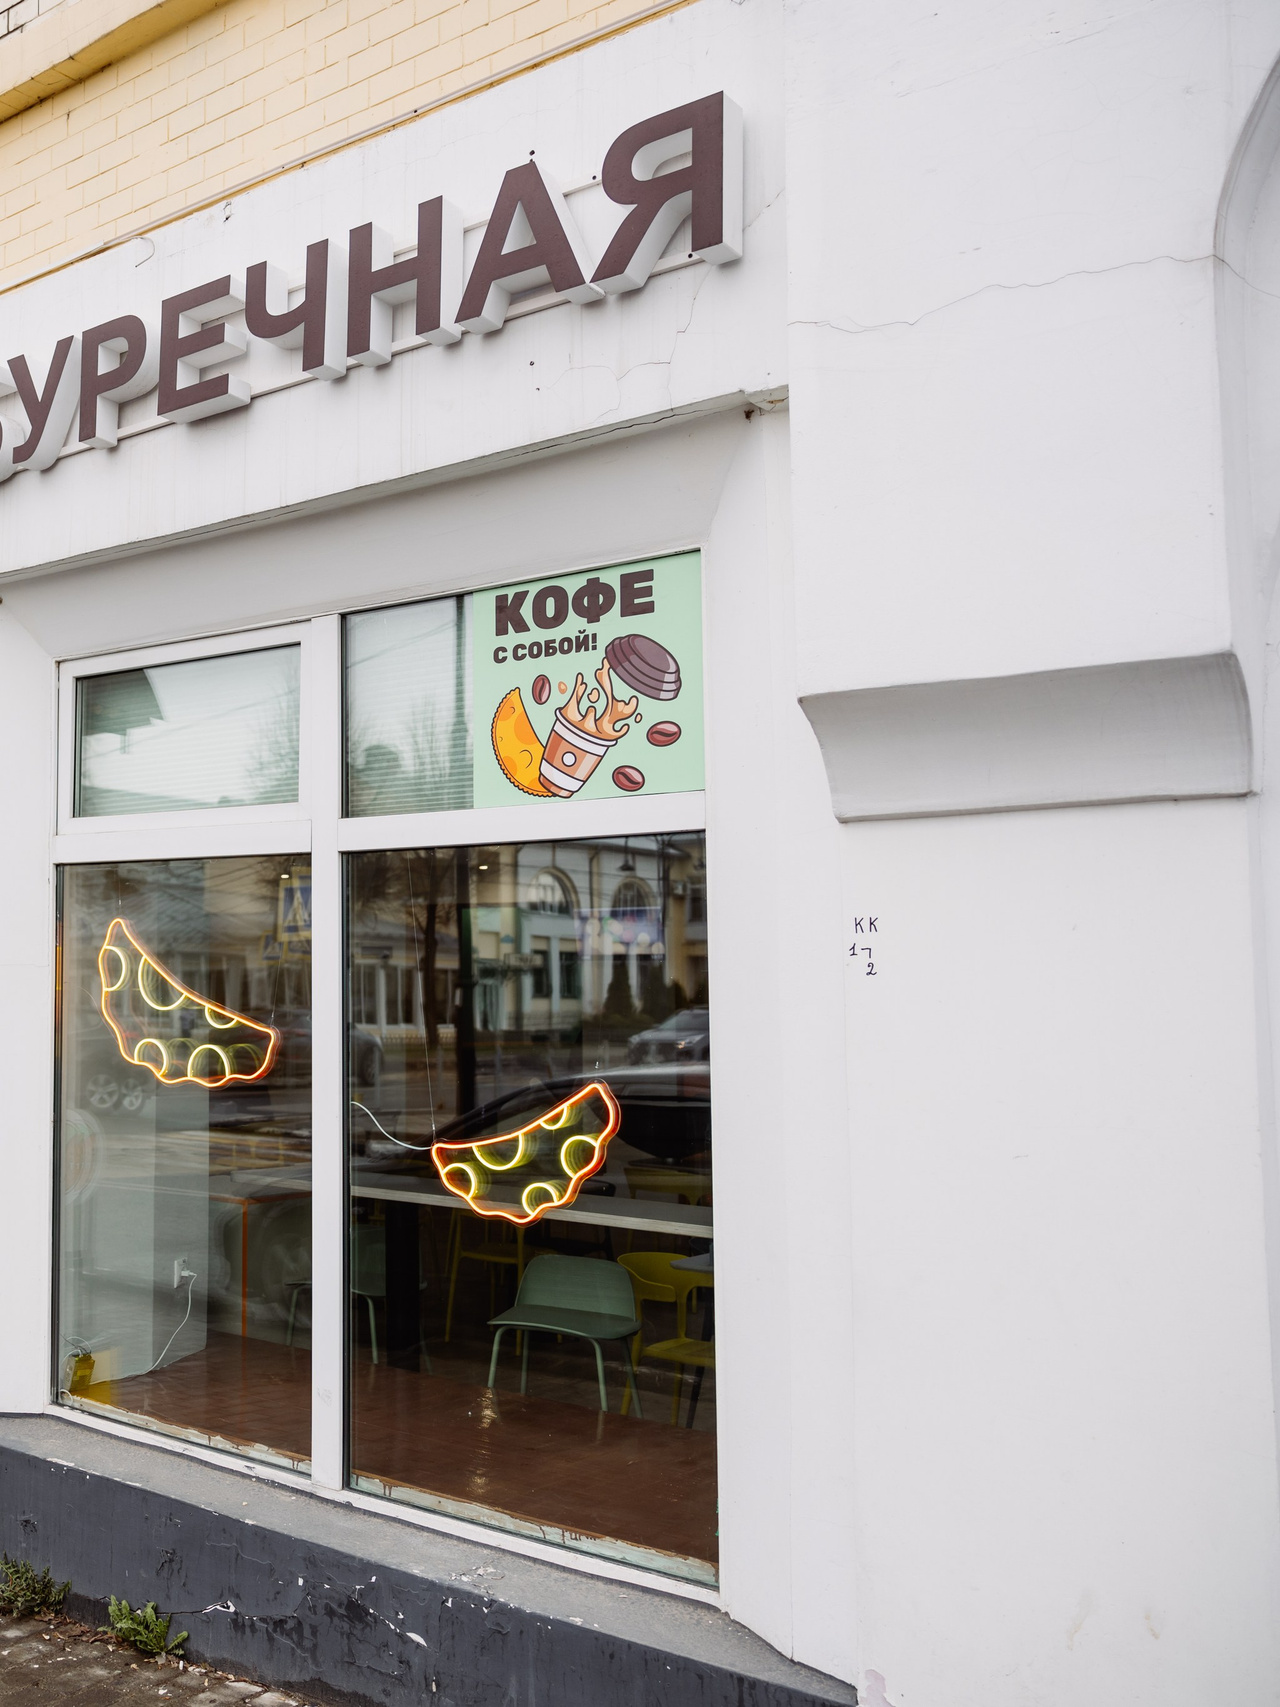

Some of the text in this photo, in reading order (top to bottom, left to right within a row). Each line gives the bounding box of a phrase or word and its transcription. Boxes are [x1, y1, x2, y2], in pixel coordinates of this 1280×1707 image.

[495, 568, 655, 637] КОФЕ
[493, 629, 598, 664] С СОБОЙ!
